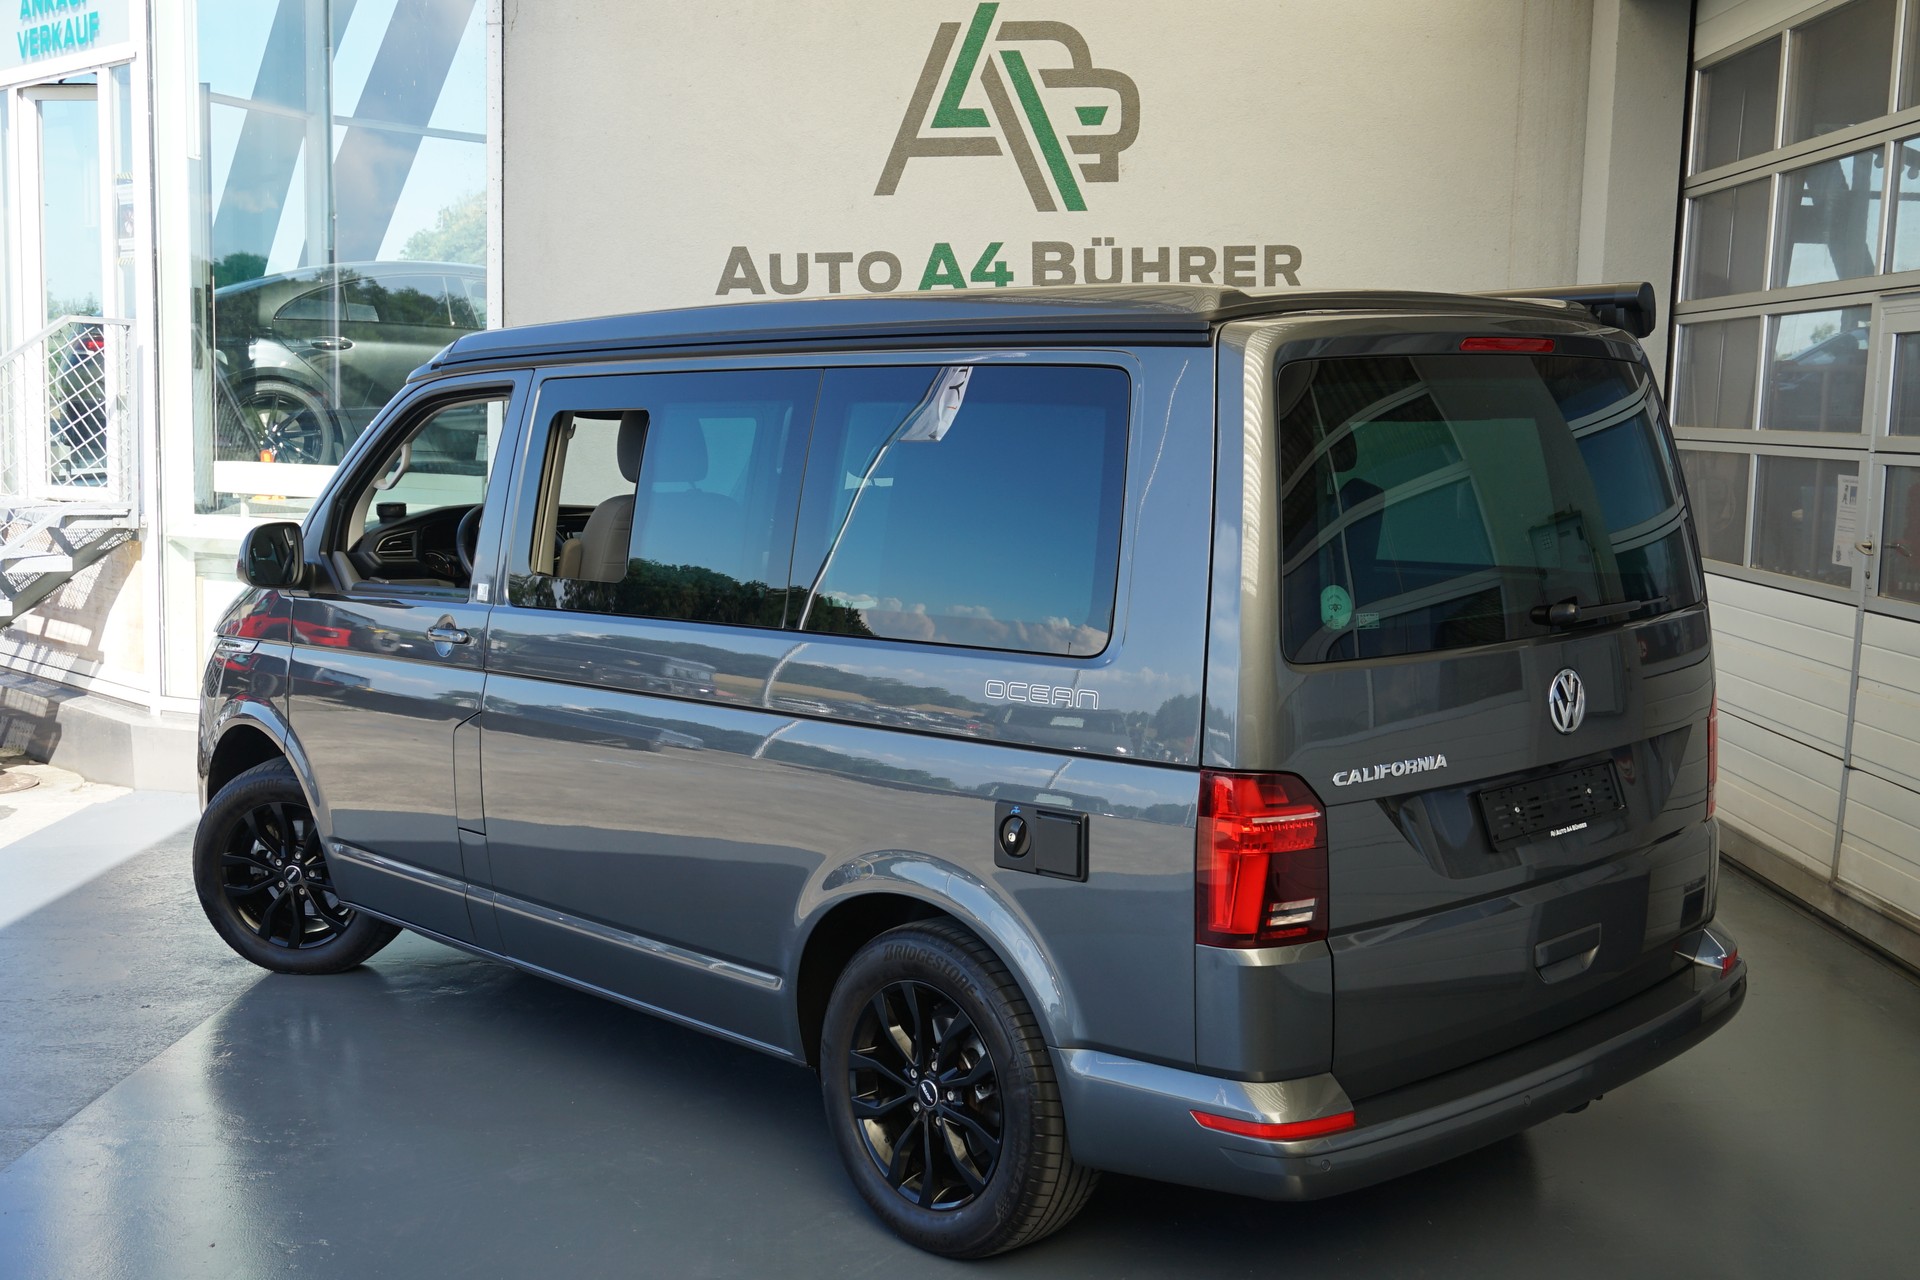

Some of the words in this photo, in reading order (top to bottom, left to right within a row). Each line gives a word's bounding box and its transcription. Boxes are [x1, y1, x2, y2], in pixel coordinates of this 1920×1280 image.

[17, 11, 98, 59] VERKAUF
[715, 246, 902, 295] AUTO
[918, 242, 1014, 290] A4
[1031, 237, 1303, 287] BÜHRER
[985, 680, 1099, 710] OCEAN
[1332, 754, 1447, 787] CALIFORNIA
[883, 944, 978, 996] BRIDGESTONE
